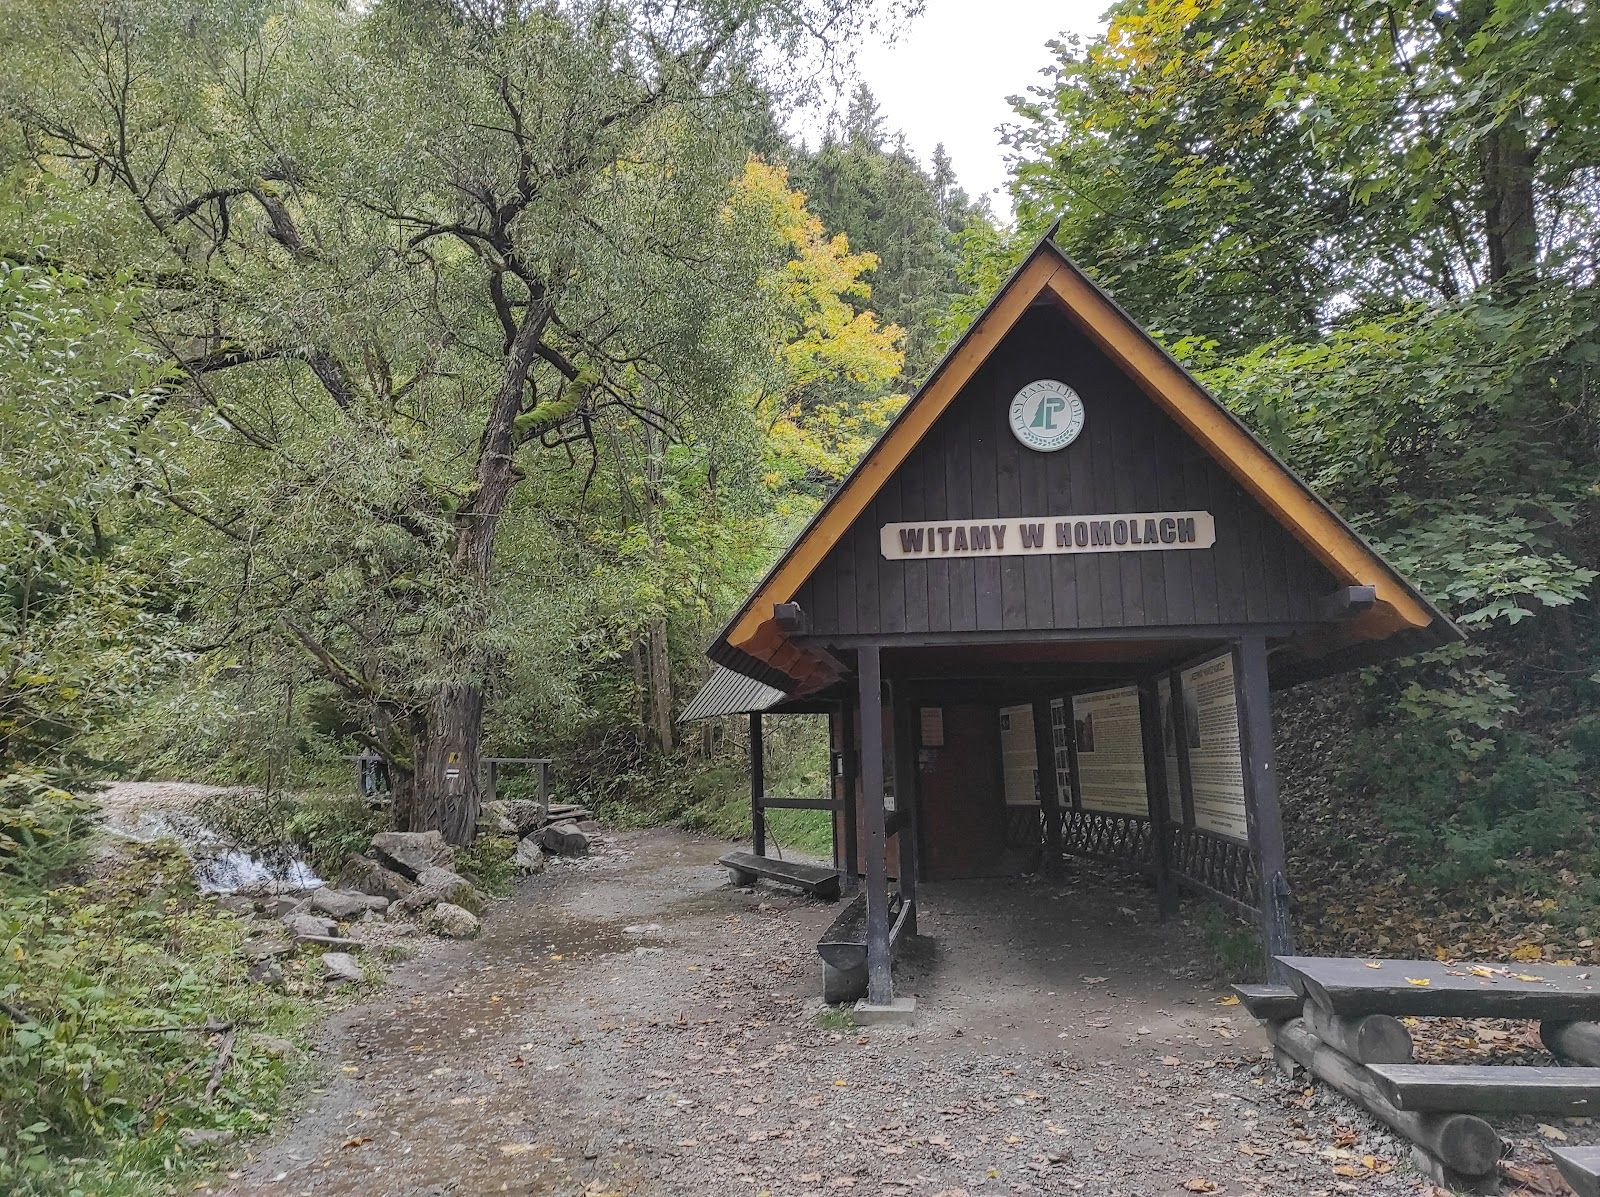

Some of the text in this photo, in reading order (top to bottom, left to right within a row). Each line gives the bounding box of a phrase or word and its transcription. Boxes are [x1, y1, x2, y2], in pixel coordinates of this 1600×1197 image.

[899, 517, 1196, 553] WITAMY W HOMOLACH
